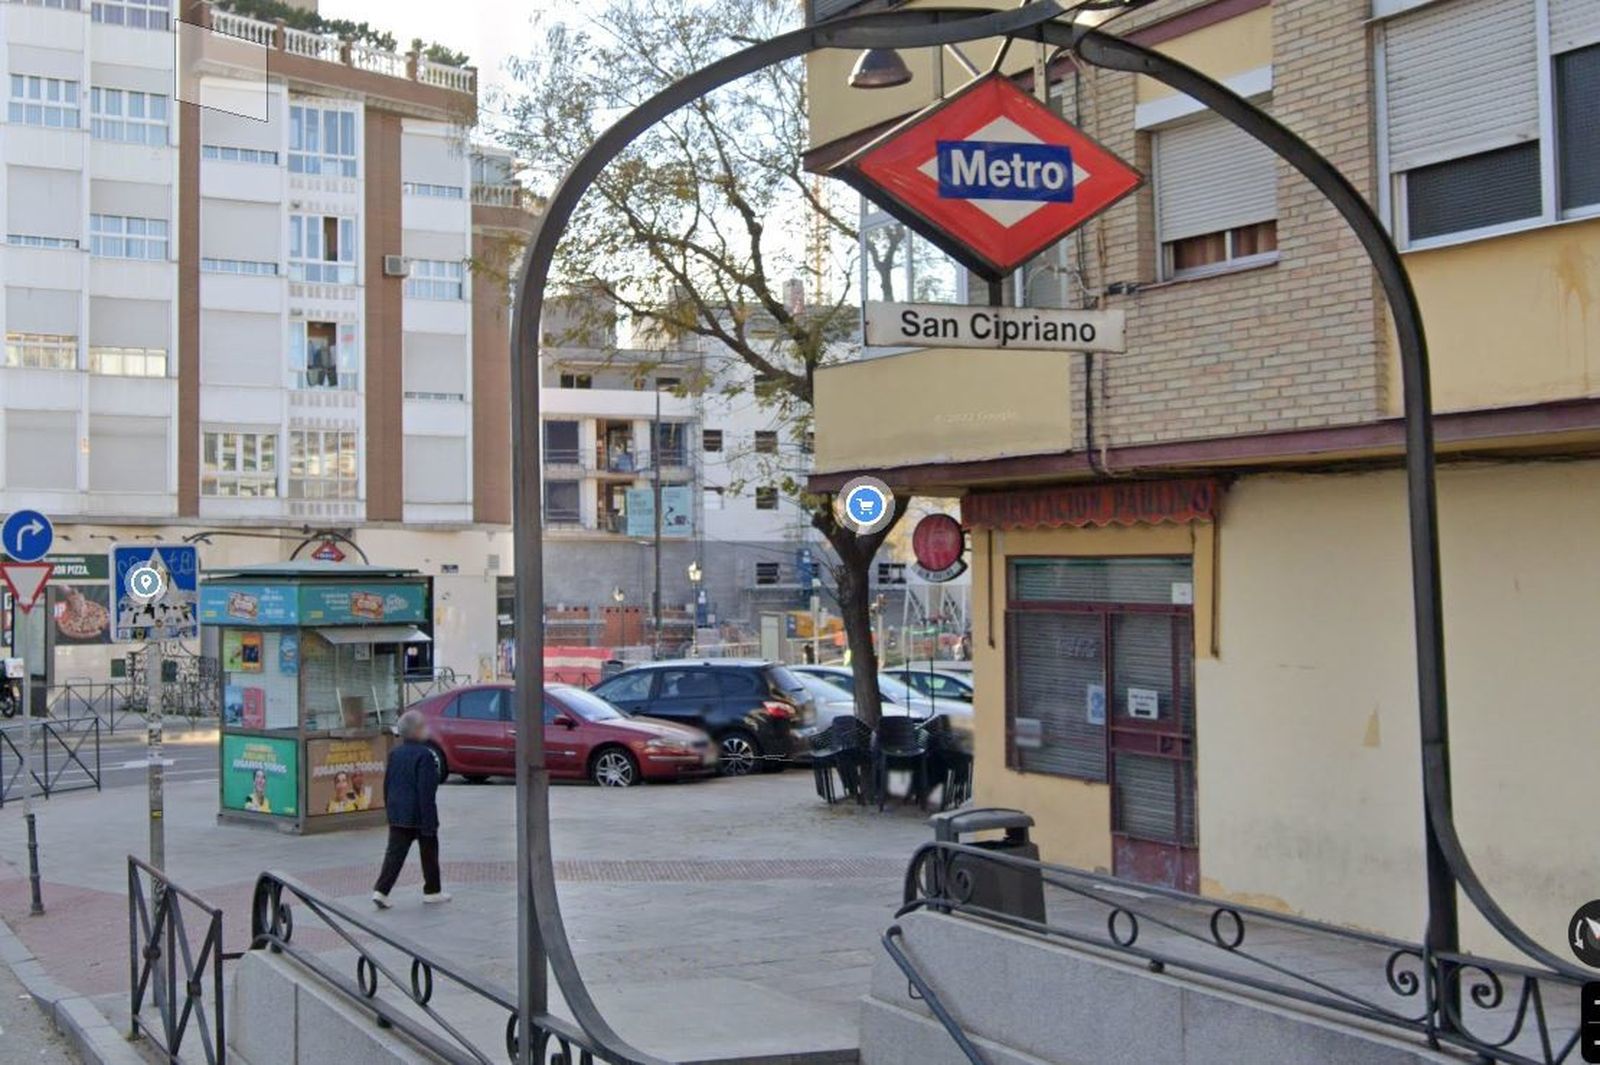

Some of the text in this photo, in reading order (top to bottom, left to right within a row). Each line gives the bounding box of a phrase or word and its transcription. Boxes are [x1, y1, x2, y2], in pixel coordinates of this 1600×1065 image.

[951, 149, 1065, 189] Metro
[901, 310, 1096, 346] San Cipriano
